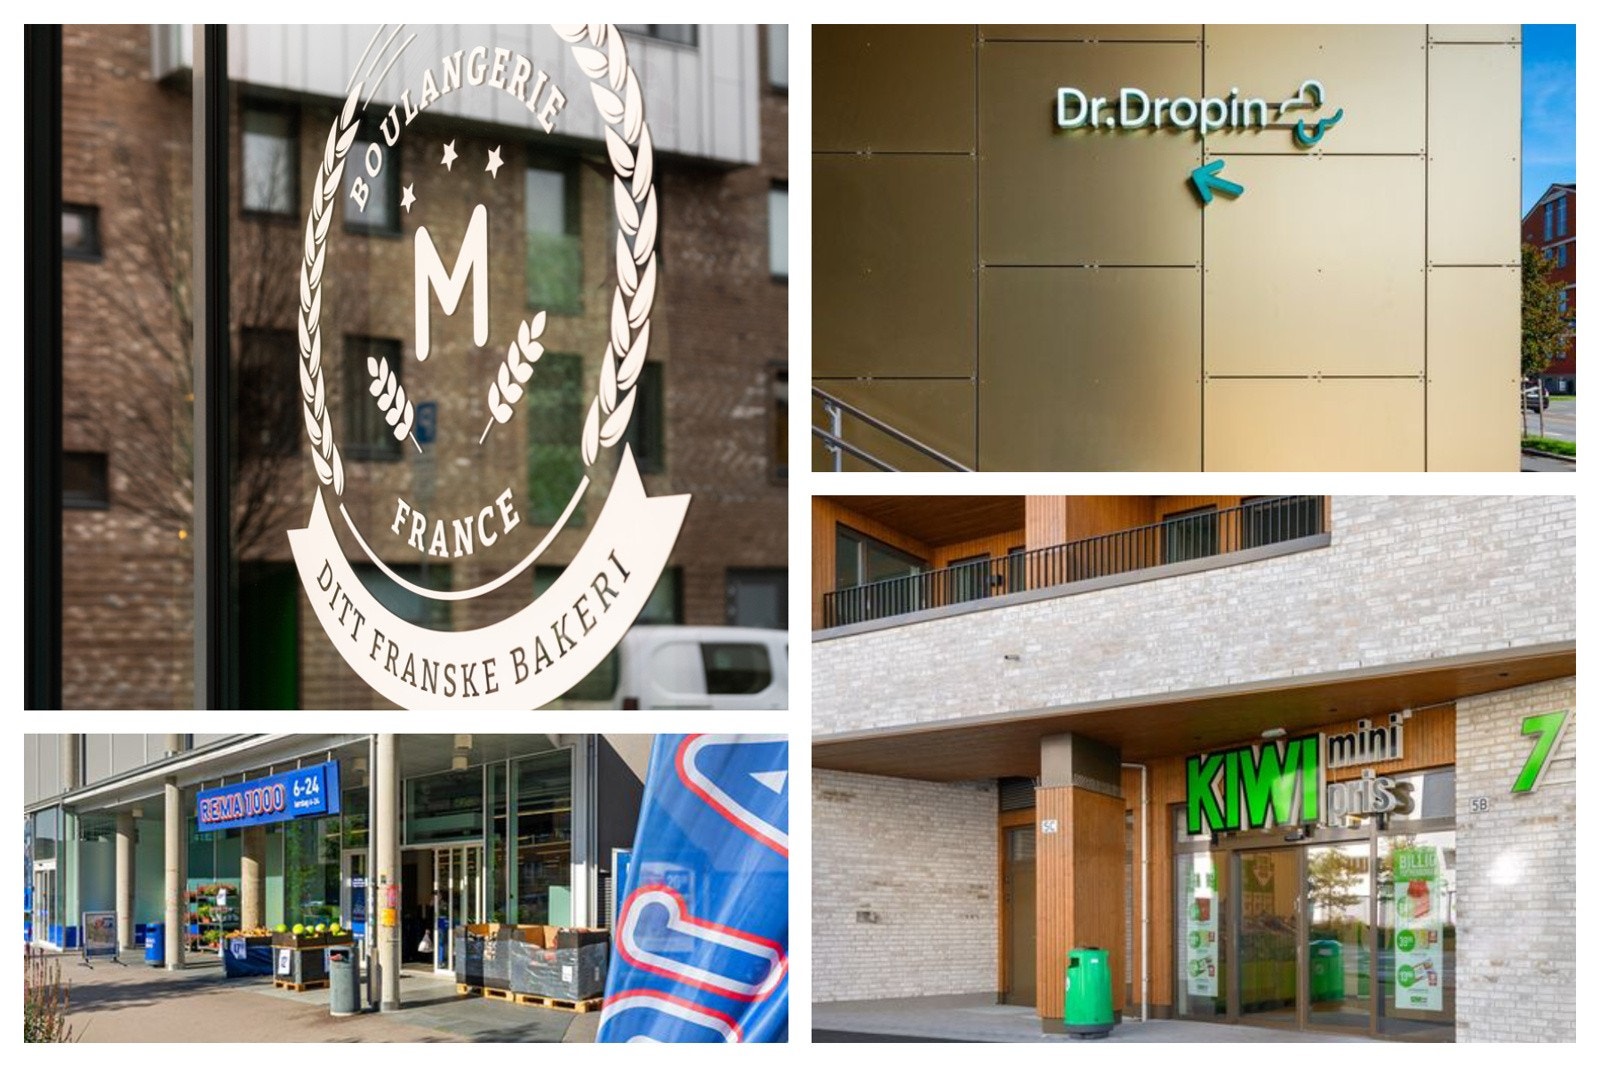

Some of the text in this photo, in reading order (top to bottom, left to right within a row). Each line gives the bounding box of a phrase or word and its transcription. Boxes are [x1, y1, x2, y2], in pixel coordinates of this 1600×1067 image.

[350, 45, 567, 213] BOULANGERIE
[1057, 87, 1268, 134] Dr.Dropin
[414, 203, 489, 362] M
[391, 487, 520, 558] FRANCE
[316, 549, 632, 698] DITT FRANSKE BAKERI
[1327, 713, 1403, 768] mini
[1510, 710, 1569, 793] 7
[200, 783, 285, 822] REMA 1000
[293, 776, 319, 797] 6-24
[1186, 732, 1325, 836] KIWI
[1327, 768, 1396, 827] pris
[1472, 798, 1487, 811] 5B
